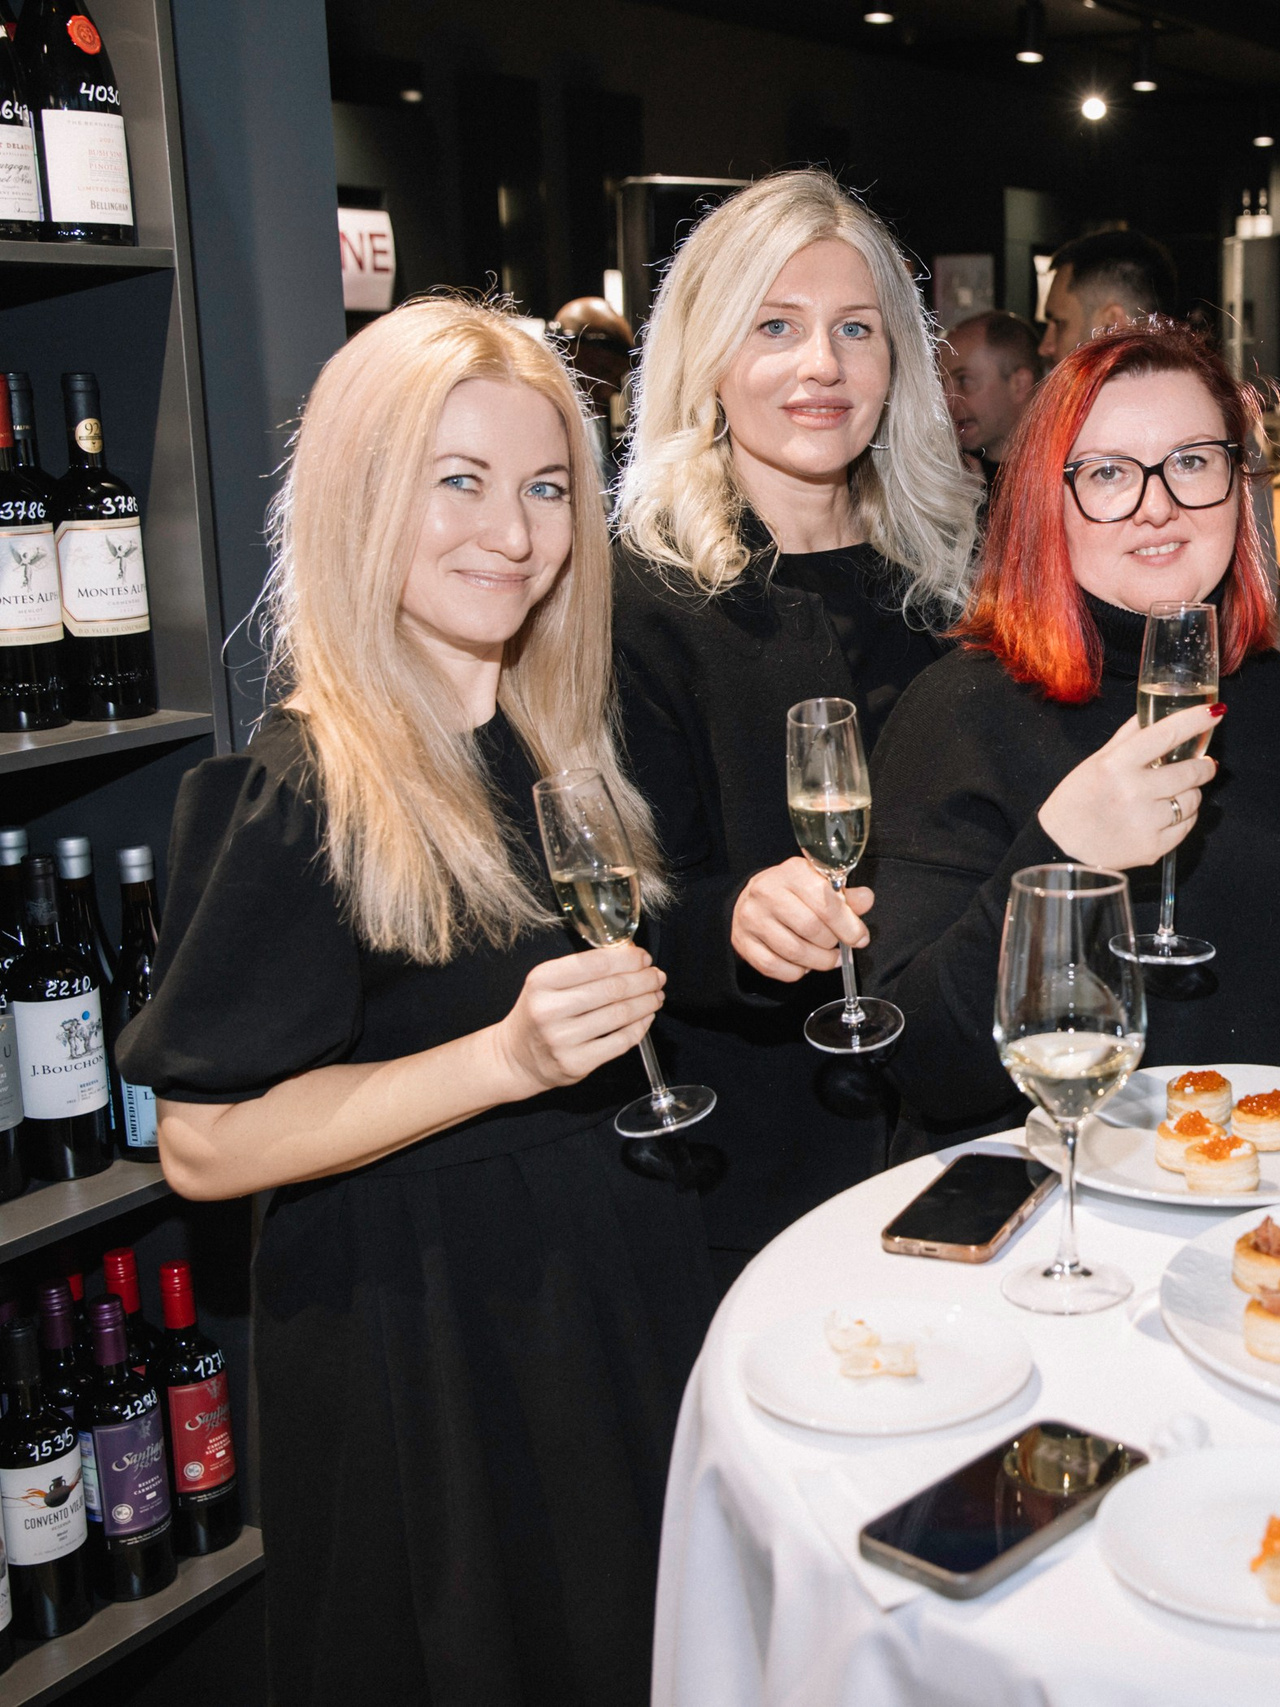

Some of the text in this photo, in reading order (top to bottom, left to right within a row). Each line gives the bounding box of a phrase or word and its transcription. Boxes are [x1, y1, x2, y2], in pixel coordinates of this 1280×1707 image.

[85, 422, 101, 436] 92
[0, 501, 46, 519] 3786
[77, 585, 129, 599] MONTES
[30, 1054, 104, 1077] J. BOUCHON
[30, 1426, 74, 1462] 1535
[24, 1506, 69, 1531] CONVENTO
